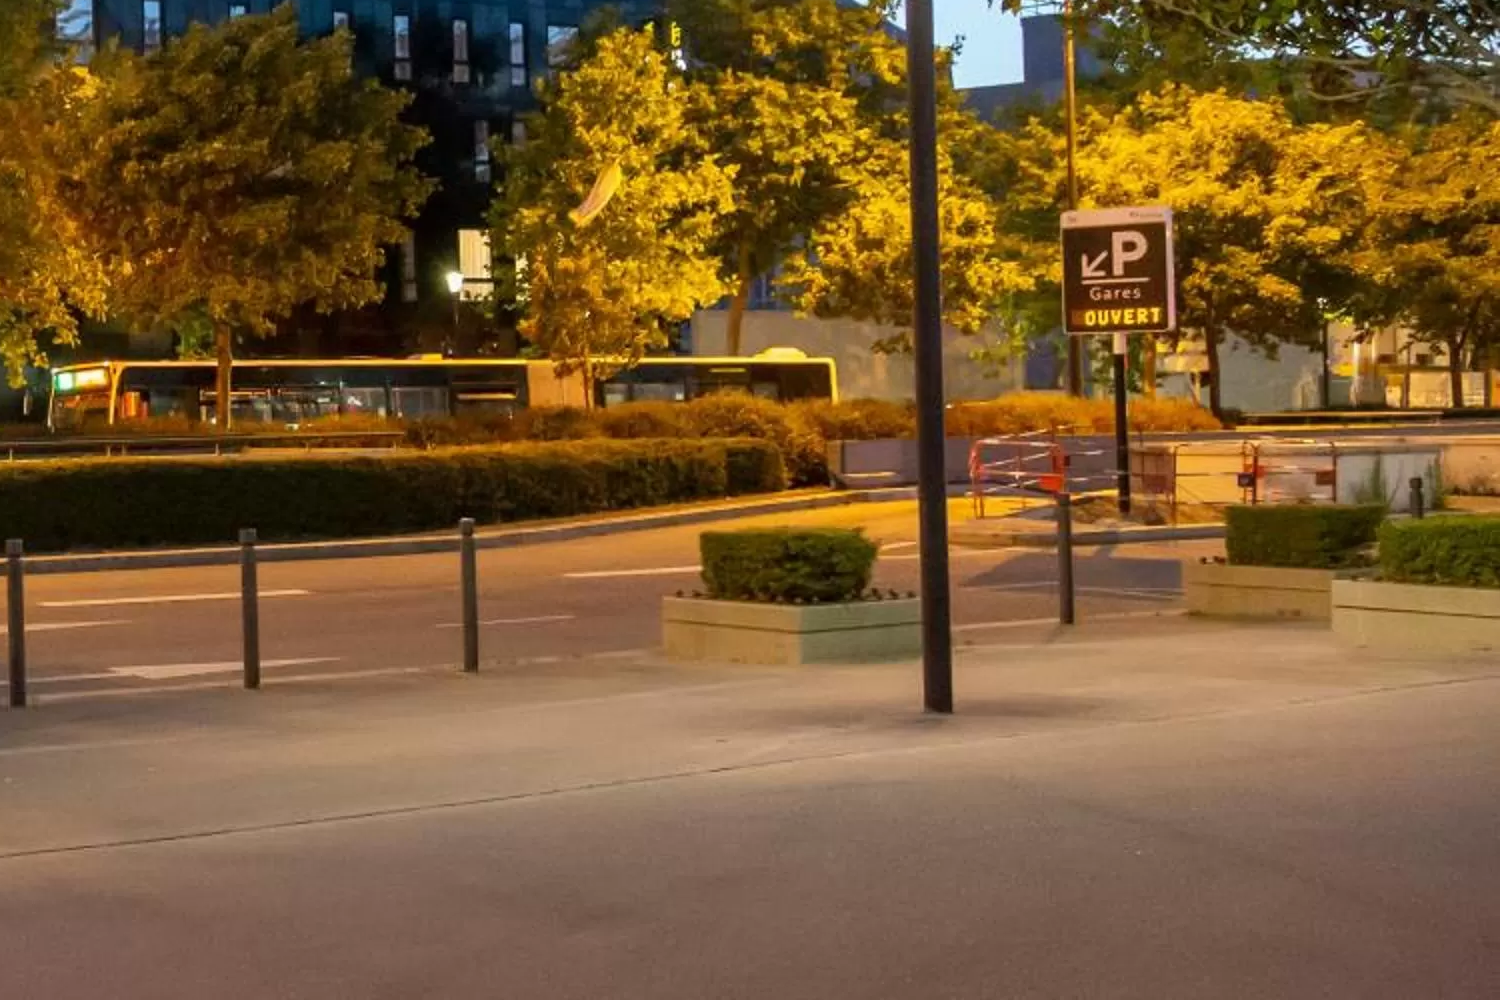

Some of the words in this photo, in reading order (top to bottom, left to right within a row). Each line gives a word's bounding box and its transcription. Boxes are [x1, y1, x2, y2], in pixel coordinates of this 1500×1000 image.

[1112, 231, 1148, 276] P
[1089, 287, 1141, 300] Gares
[1084, 308, 1161, 326] OUVERT
